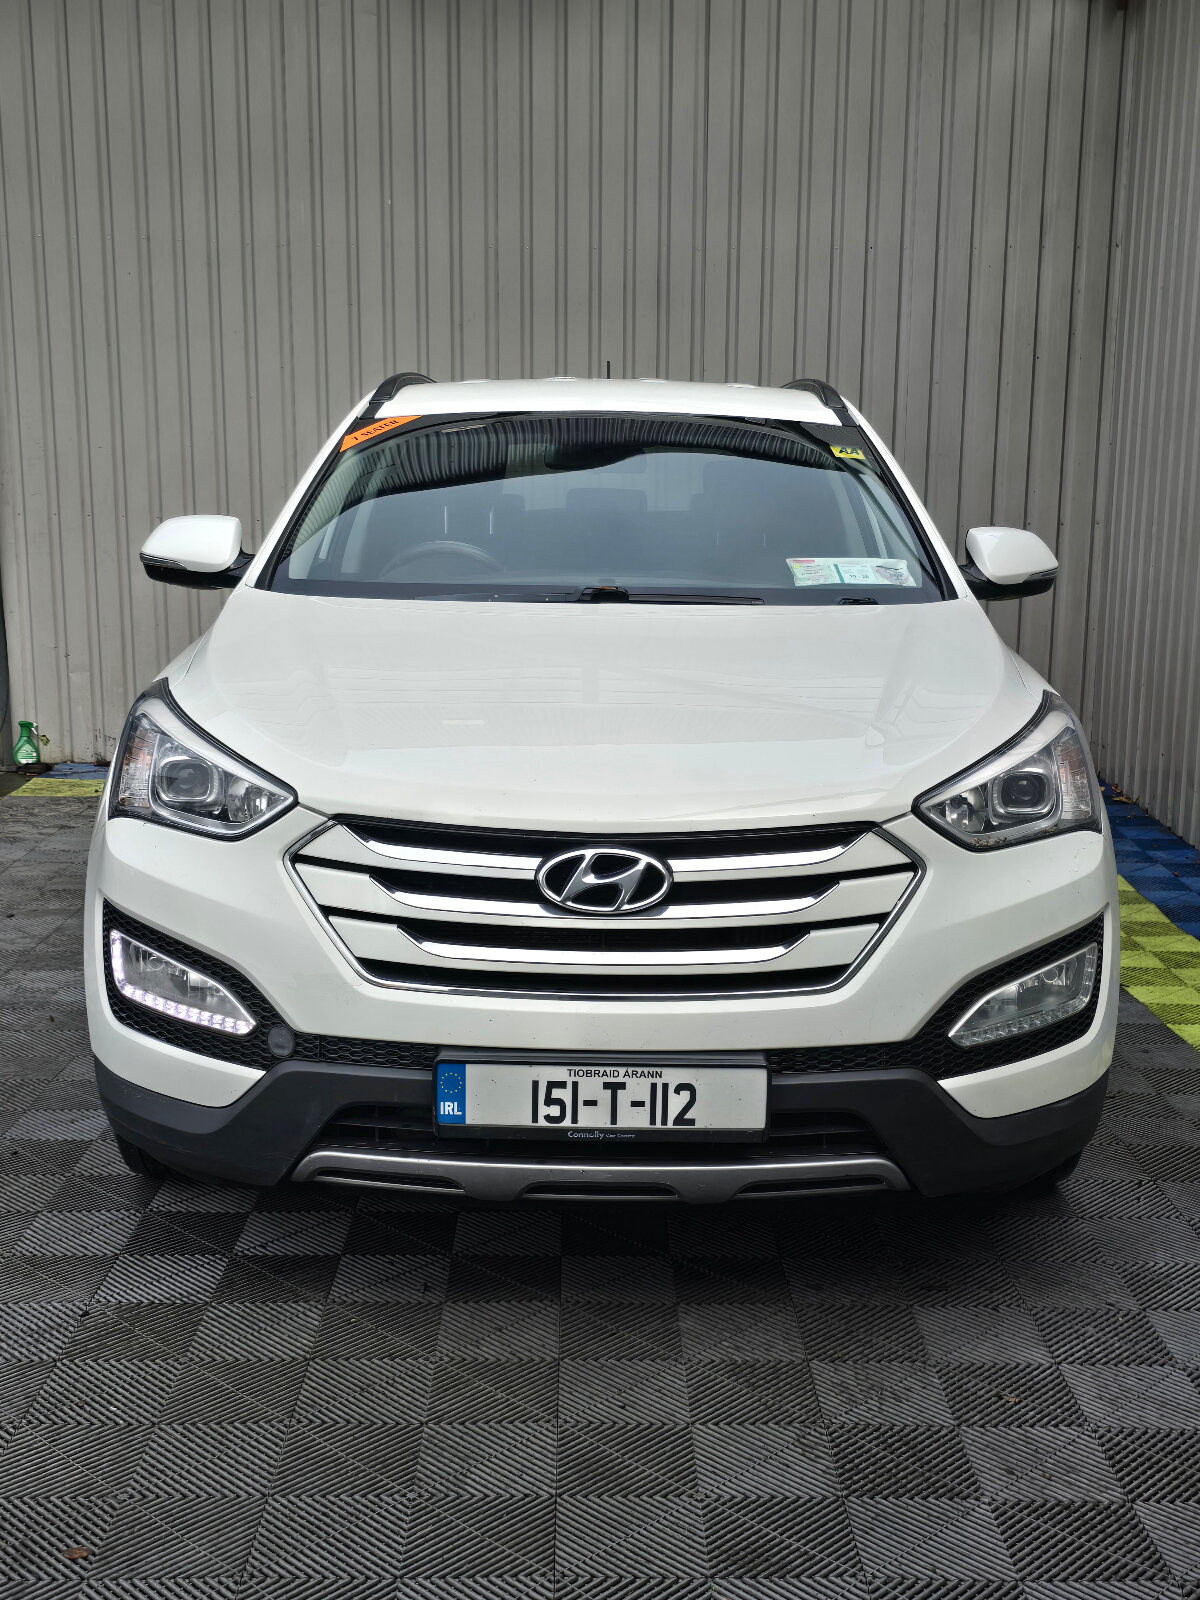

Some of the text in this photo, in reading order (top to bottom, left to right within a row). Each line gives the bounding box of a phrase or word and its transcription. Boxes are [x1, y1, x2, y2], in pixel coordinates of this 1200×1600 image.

[567, 1067, 663, 1079] TIOBRAID ÁRANN
[440, 1101, 462, 1115] IRL
[531, 1079, 697, 1127] 151-T-112
[567, 1130, 604, 1140] Connolly
